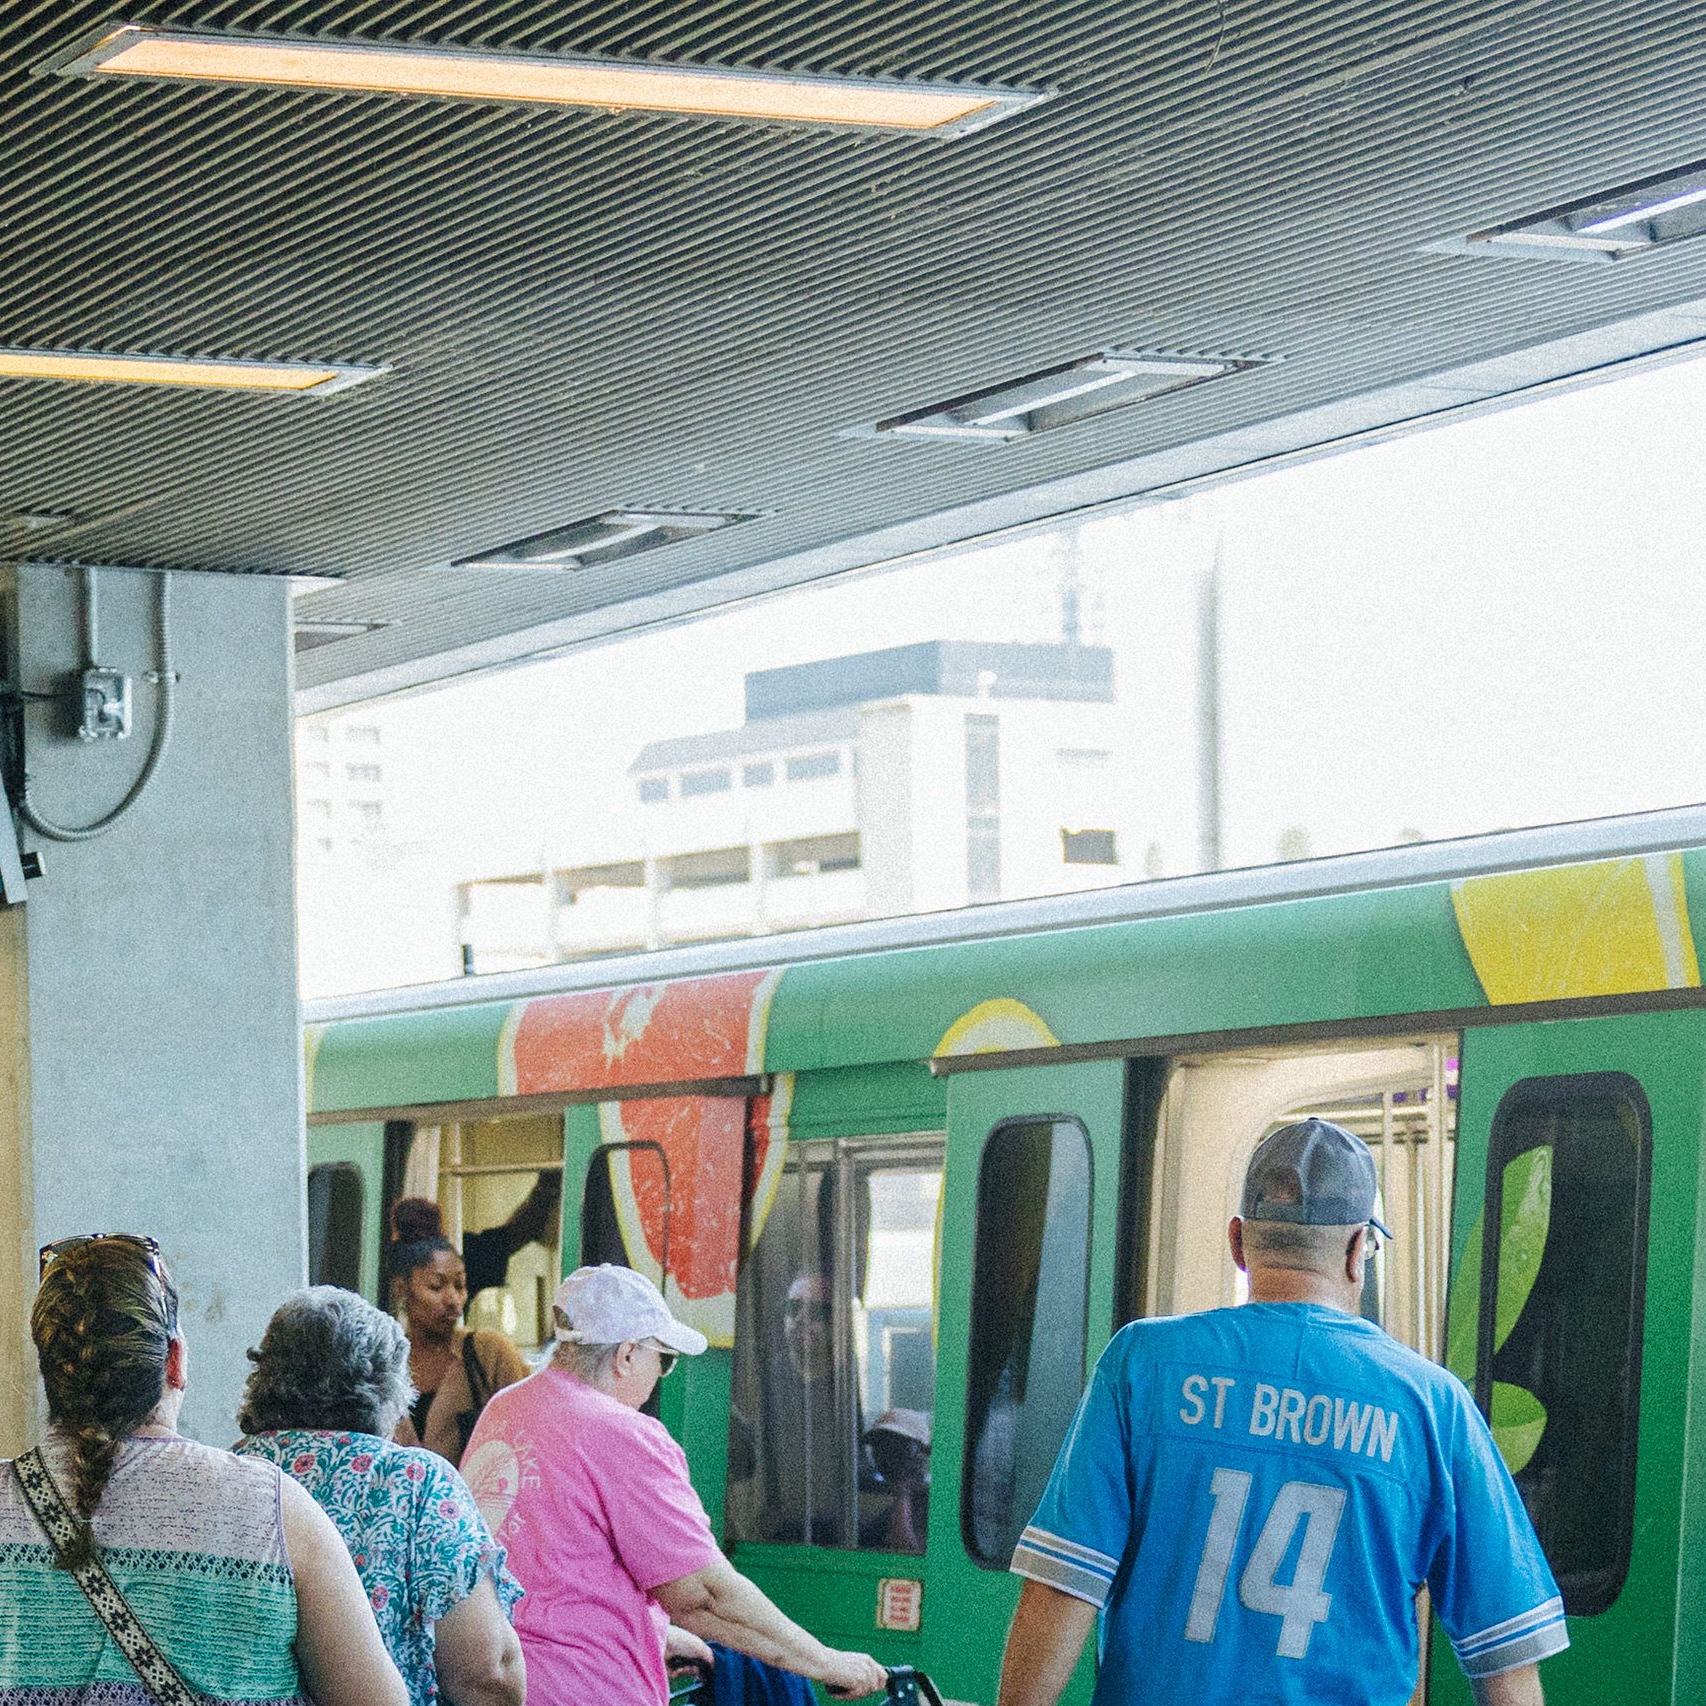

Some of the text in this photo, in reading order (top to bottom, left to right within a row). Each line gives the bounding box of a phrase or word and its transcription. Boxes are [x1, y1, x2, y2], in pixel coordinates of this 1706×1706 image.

[1180, 1374, 1399, 1463] ST BROWN
[1184, 1466, 1348, 1660] 14
